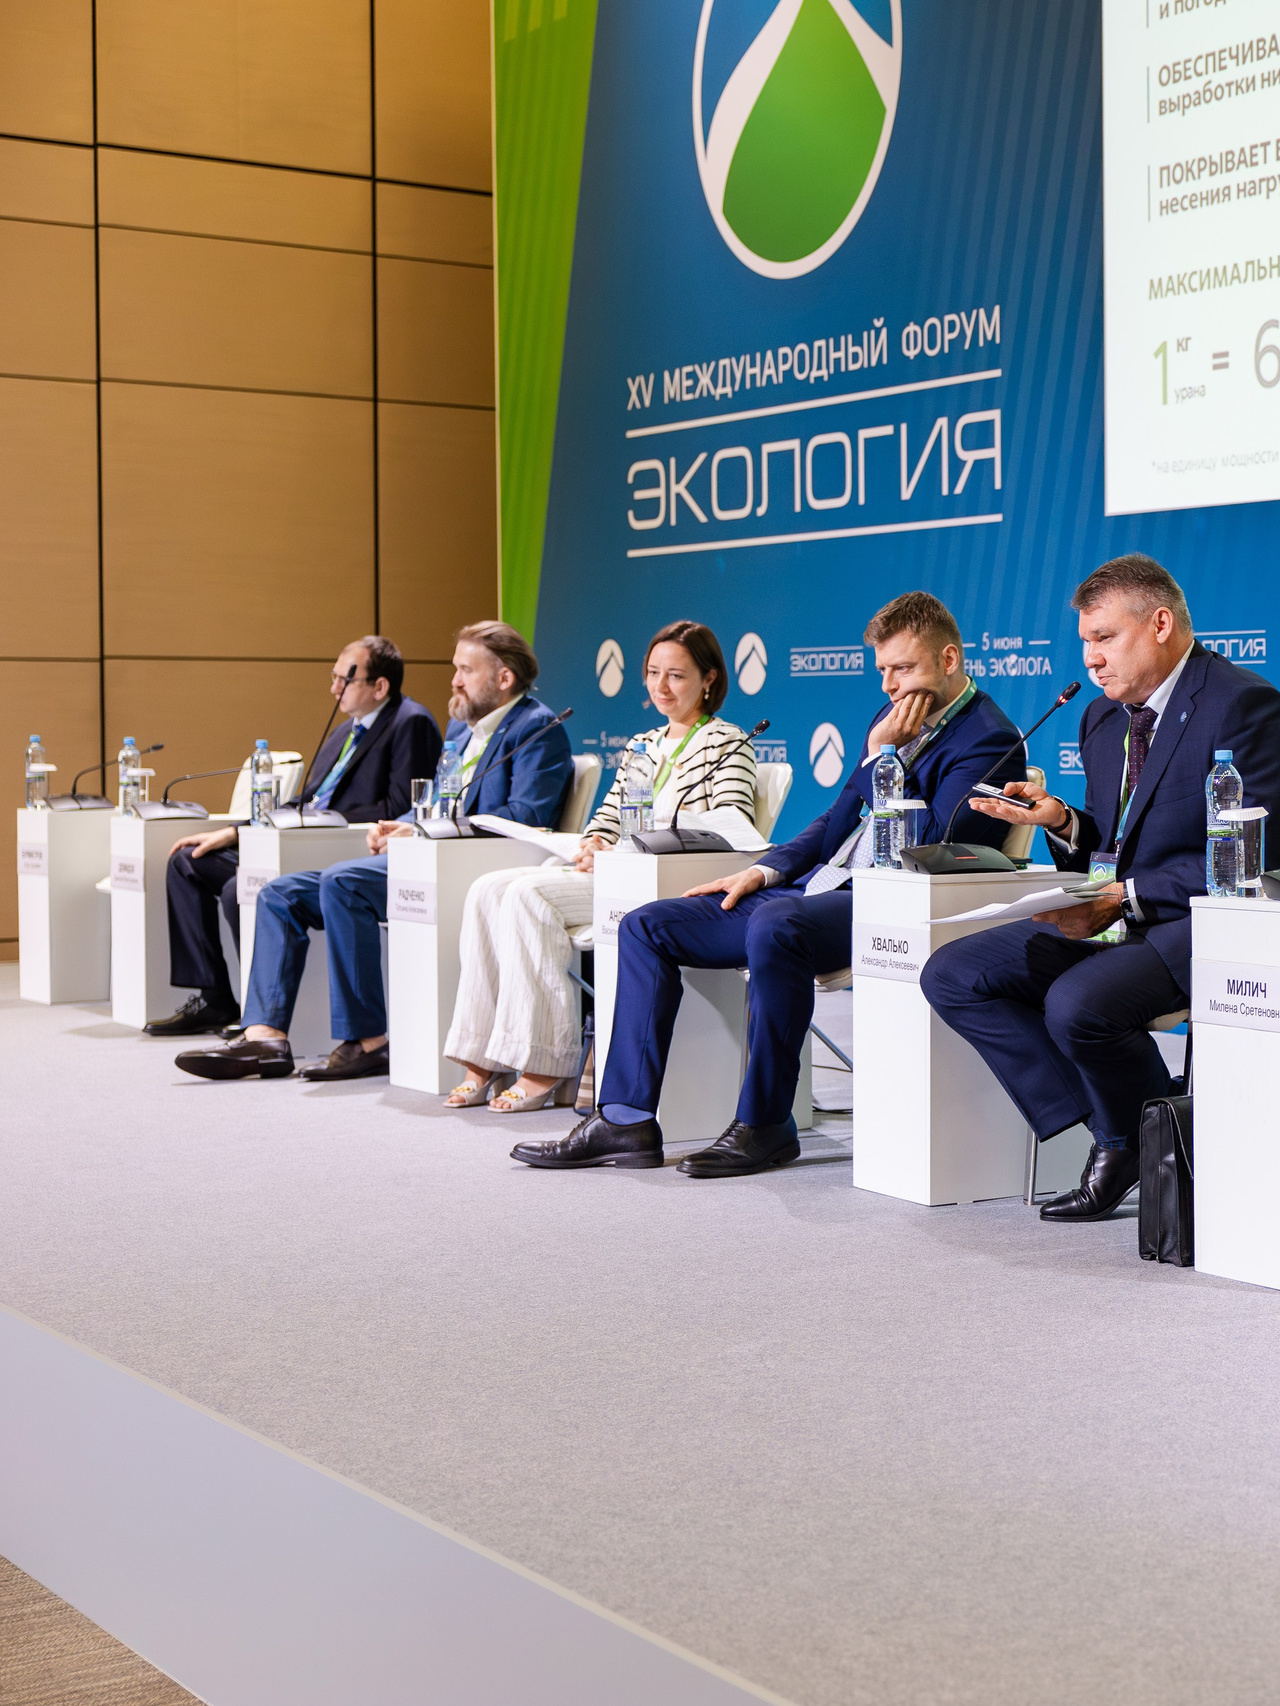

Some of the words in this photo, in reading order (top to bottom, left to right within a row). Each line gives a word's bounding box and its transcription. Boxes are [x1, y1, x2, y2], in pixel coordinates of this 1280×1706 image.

[1158, 76, 1257, 117] выработки
[1159, 141, 1270, 189] ПОКРЫВАЕТ
[1159, 184, 1231, 217] несения
[1175, 336, 1192, 354] кг
[625, 371, 655, 412] XV
[663, 316, 888, 405] МЕЖДУНАРОДНЫЙ
[902, 304, 1001, 360] ФОРУМ
[1152, 340, 1169, 406] 1
[1174, 382, 1207, 404] урана
[626, 408, 1002, 531] ЭКОЛОГИЯ
[1220, 450, 1280, 468] мощности
[981, 632, 990, 651] 5
[993, 637, 1023, 651] июня
[789, 651, 865, 672] ЭКОЛОГИЯ
[871, 936, 909, 955] ХВАЛЬКО
[861, 954, 888, 970] Александр
[1226, 977, 1268, 999] МИЛИЧ
[1209, 998, 1238, 1016] Милена
